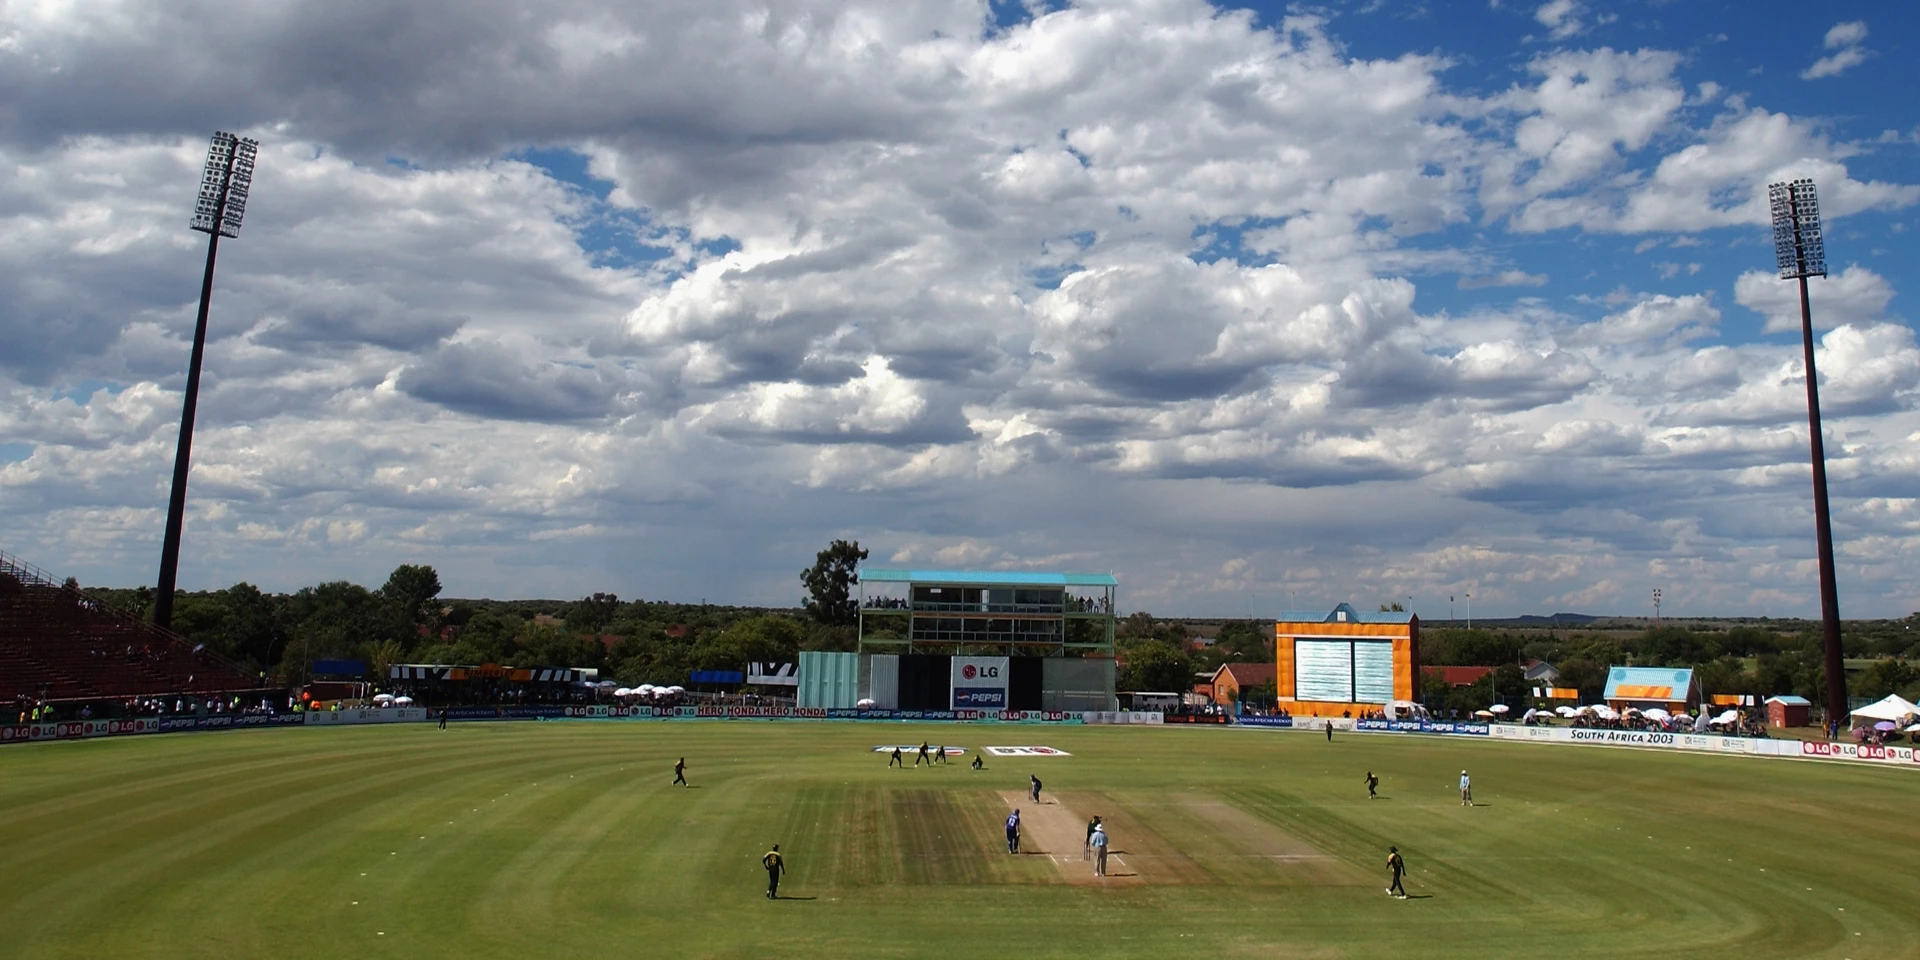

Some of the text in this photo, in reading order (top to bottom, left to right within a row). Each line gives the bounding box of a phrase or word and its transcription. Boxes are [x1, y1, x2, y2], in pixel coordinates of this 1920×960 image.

[980, 667, 998, 678] LG
[971, 693, 1002, 702] PEPSI
[698, 707, 826, 717] HERO HONDA HERO HONDA
[207, 717, 232, 725] PEPSI
[279, 714, 303, 722] PEPSI
[70, 725, 83, 734] LG
[96, 723, 108, 732] LG
[121, 722, 133, 731] LG
[147, 721, 158, 729] LG
[1365, 721, 1388, 729] PEPSI
[1397, 722, 1420, 730] PEPSI
[1464, 725, 1487, 733] PEPSI
[15, 728, 28, 738] LG
[43, 727, 56, 735] LG
[1571, 730, 1674, 744] SOUTH AFRICA 2003
[1816, 744, 1830, 753] LG
[1843, 746, 1857, 755] LG
[1870, 748, 1884, 757] LG
[1899, 751, 1912, 759] LG
